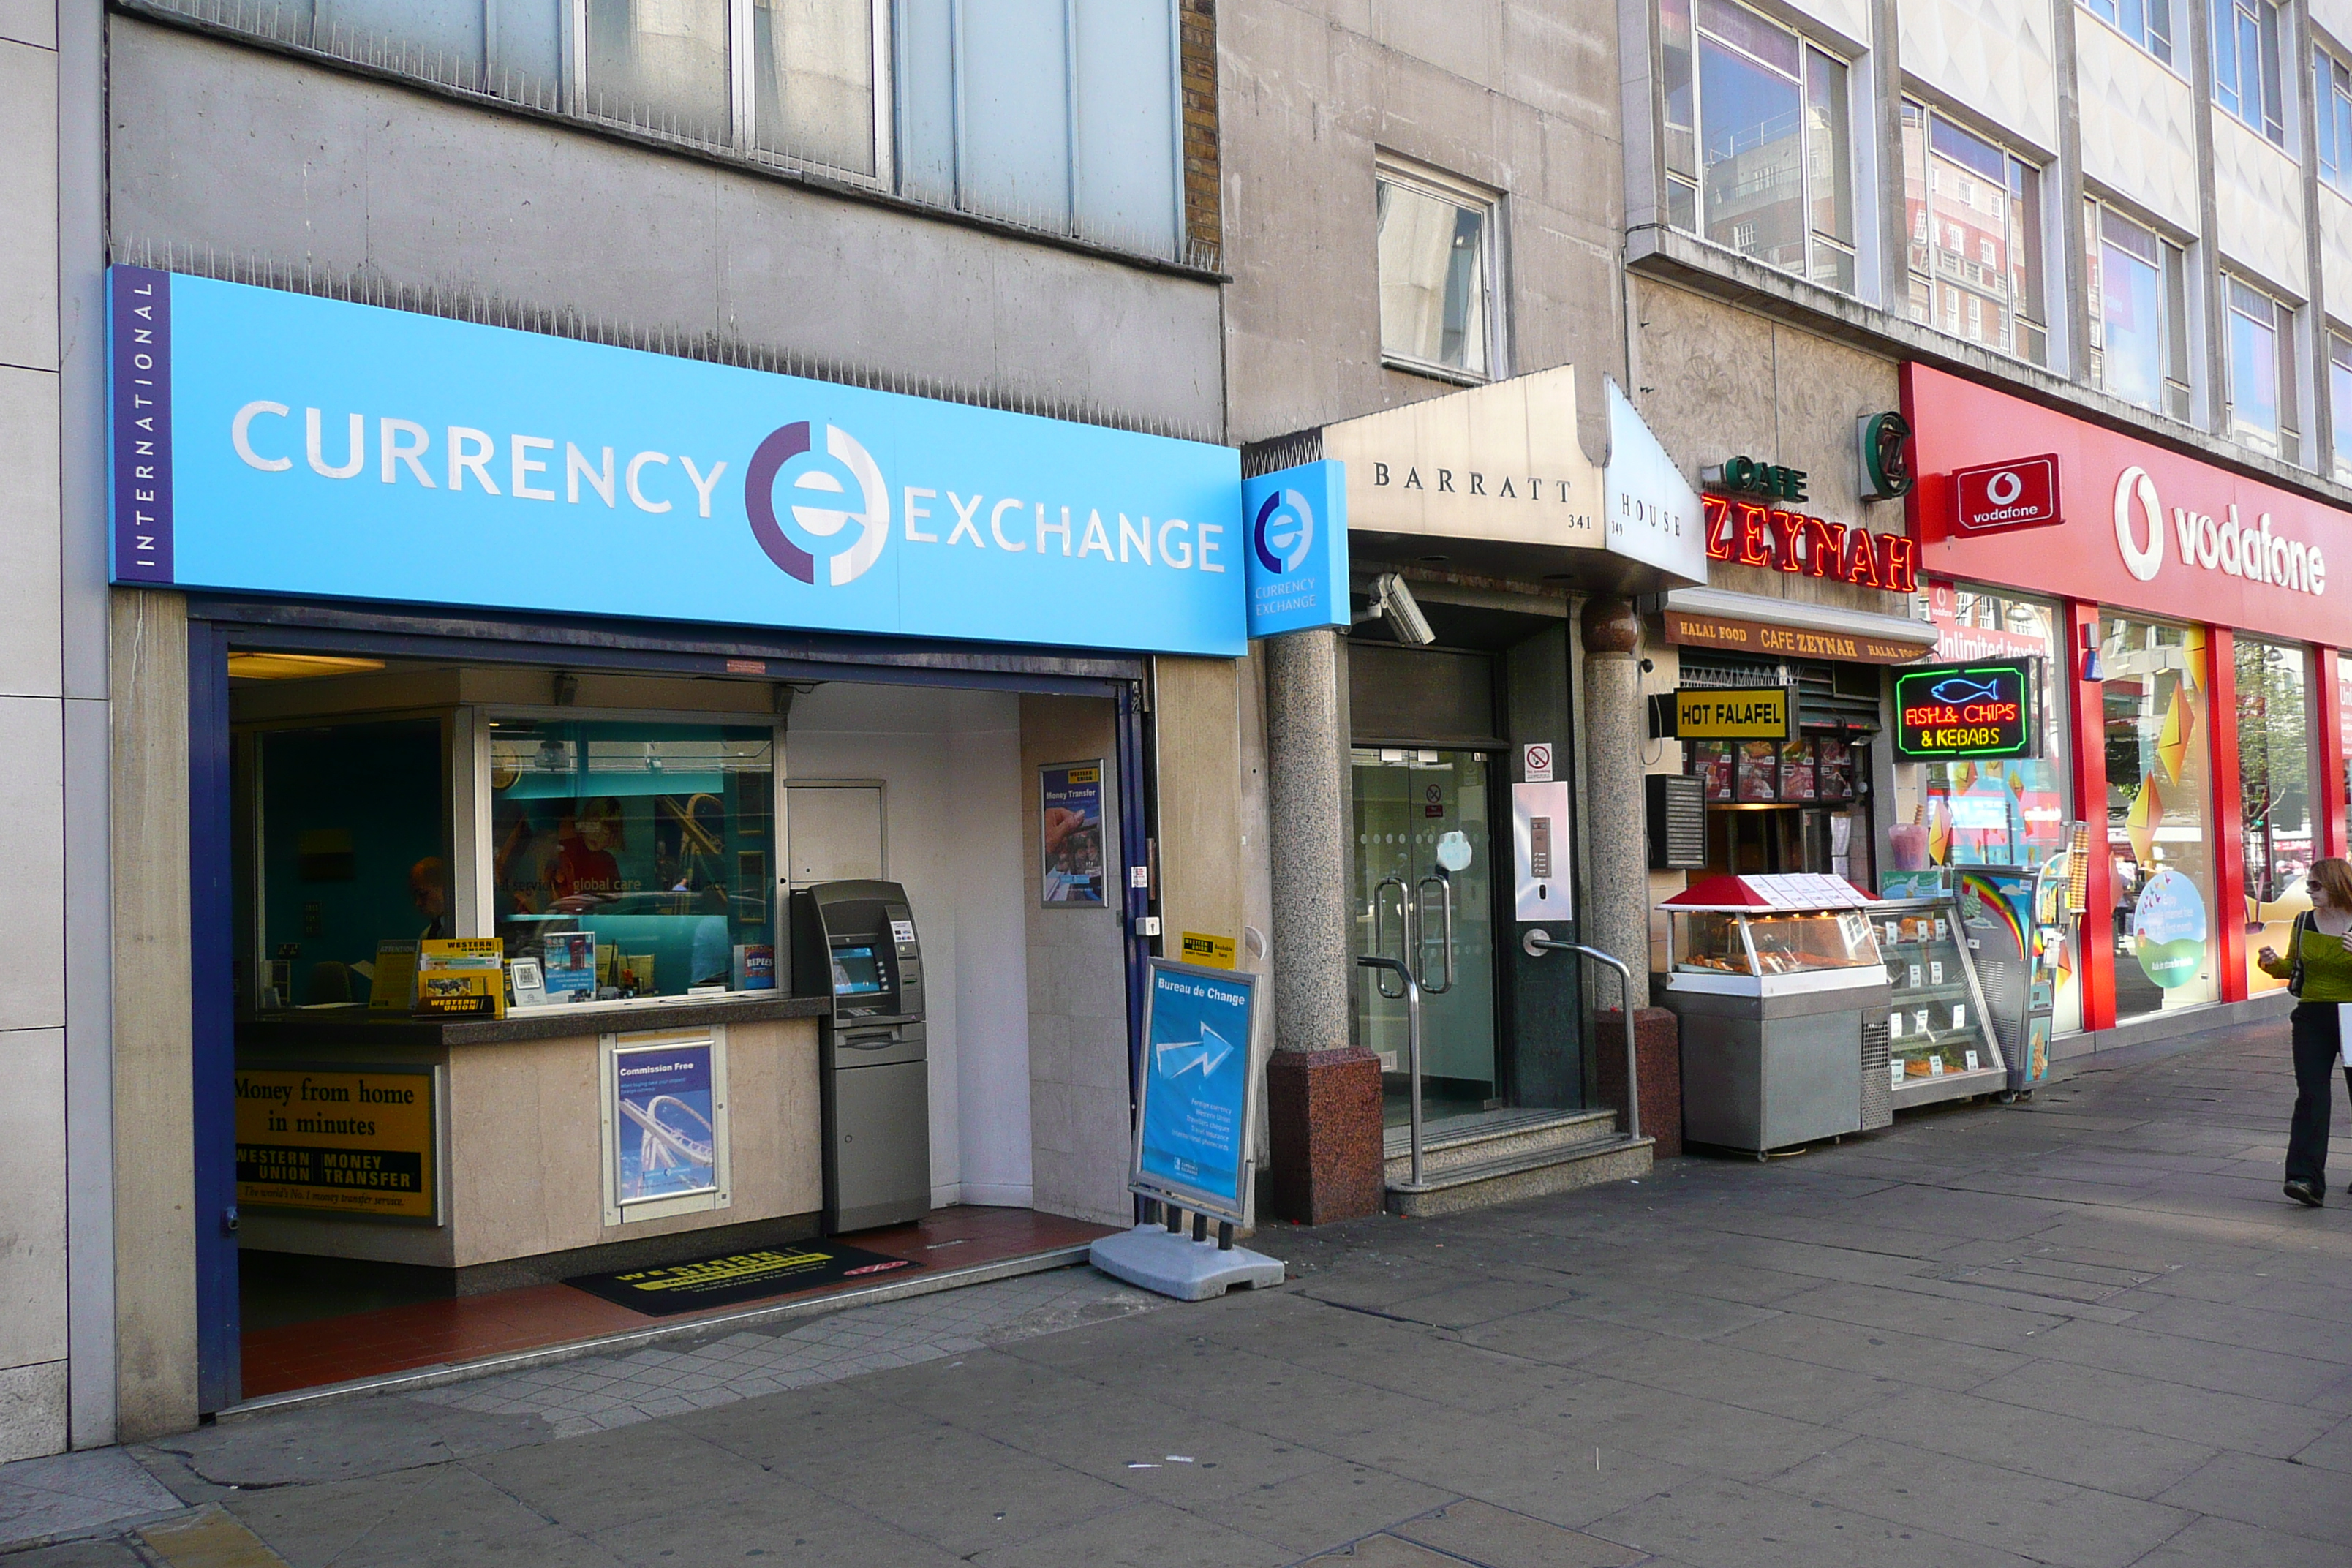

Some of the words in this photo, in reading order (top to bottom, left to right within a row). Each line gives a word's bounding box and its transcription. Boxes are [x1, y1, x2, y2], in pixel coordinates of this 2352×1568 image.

[135, 282, 155, 567] INTERNATIONAL
[230, 399, 728, 519] CURRENCY
[903, 485, 1226, 573] EXCHANGE
[1373, 461, 1572, 504] BARRATT
[1621, 492, 1682, 538] HOUSE
[1567, 513, 1593, 530] 341
[1972, 504, 2038, 524] vodafone
[1610, 519, 1624, 537] 349
[1701, 492, 1918, 592] ZEYNAH
[2172, 503, 2326, 596] vodafone
[1255, 577, 1316, 600] CURRENCY
[1255, 594, 1316, 617] EXCHANGE
[1680, 621, 1717, 639] HALAL
[1719, 625, 1748, 642] FOOD
[1760, 628, 1795, 651] CAFE
[1796, 633, 1858, 657] ZEYNAH
[1866, 644, 1899, 658] HALAL
[1681, 703, 1711, 725] HOT
[1715, 702, 1782, 725] FALAFEL
[1905, 706, 1939, 725] FISH
[1964, 704, 2017, 723] CHIPS
[1921, 730, 1934, 747] &
[1937, 728, 2001, 747] KEBABS
[1046, 791, 1068, 800] Money
[1068, 789, 1096, 798] Transfer
[573, 876, 611, 895] global
[614, 879, 643, 892] care
[447, 940, 492, 949] WESTERN
[431, 998, 478, 1006] WESTERN
[1158, 977, 1191, 995] Bureau
[1193, 984, 1205, 997] de
[1207, 987, 1245, 1007] Change
[619, 1064, 673, 1077] Commission
[674, 1062, 695, 1071] Free
[235, 1078, 293, 1107] Money
[301, 1077, 350, 1103] from
[358, 1079, 415, 1104] home
[268, 1109, 287, 1131] in
[296, 1112, 376, 1136] minutes
[236, 1148, 310, 1166] WESTERN
[323, 1153, 382, 1170] MONEY
[258, 1164, 310, 1182] UNION
[323, 1168, 411, 1188] TRANSFER
[244, 1185, 258, 1197] The
[312, 1193, 339, 1205] money
[340, 1191, 373, 1207] transfer
[614, 1251, 774, 1281] WESTERN
[674, 1254, 785, 1278] UNION
